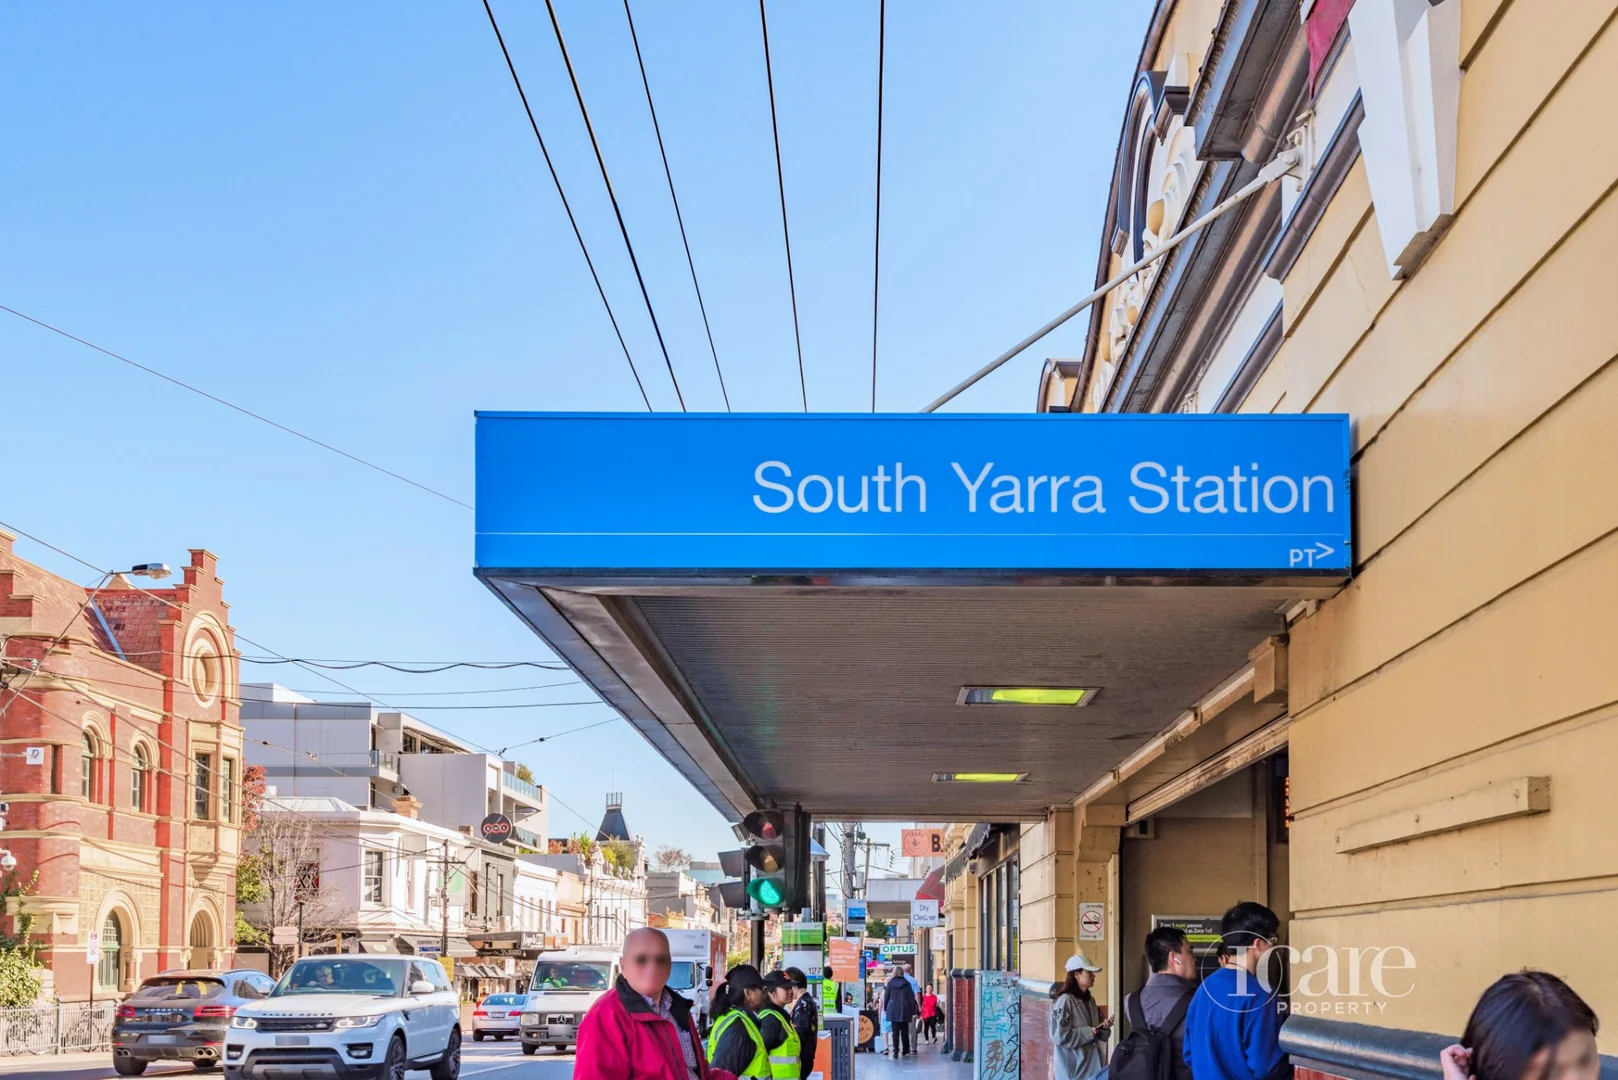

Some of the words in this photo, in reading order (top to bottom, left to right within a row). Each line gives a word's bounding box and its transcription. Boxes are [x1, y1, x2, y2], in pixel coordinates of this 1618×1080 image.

[752, 460, 927, 514] South
[950, 461, 1106, 514] Yarra
[1127, 459, 1334, 514] Station
[919, 904, 930, 912] Dry
[882, 945, 915, 953] OPTUS
[808, 967, 822, 975] 127
